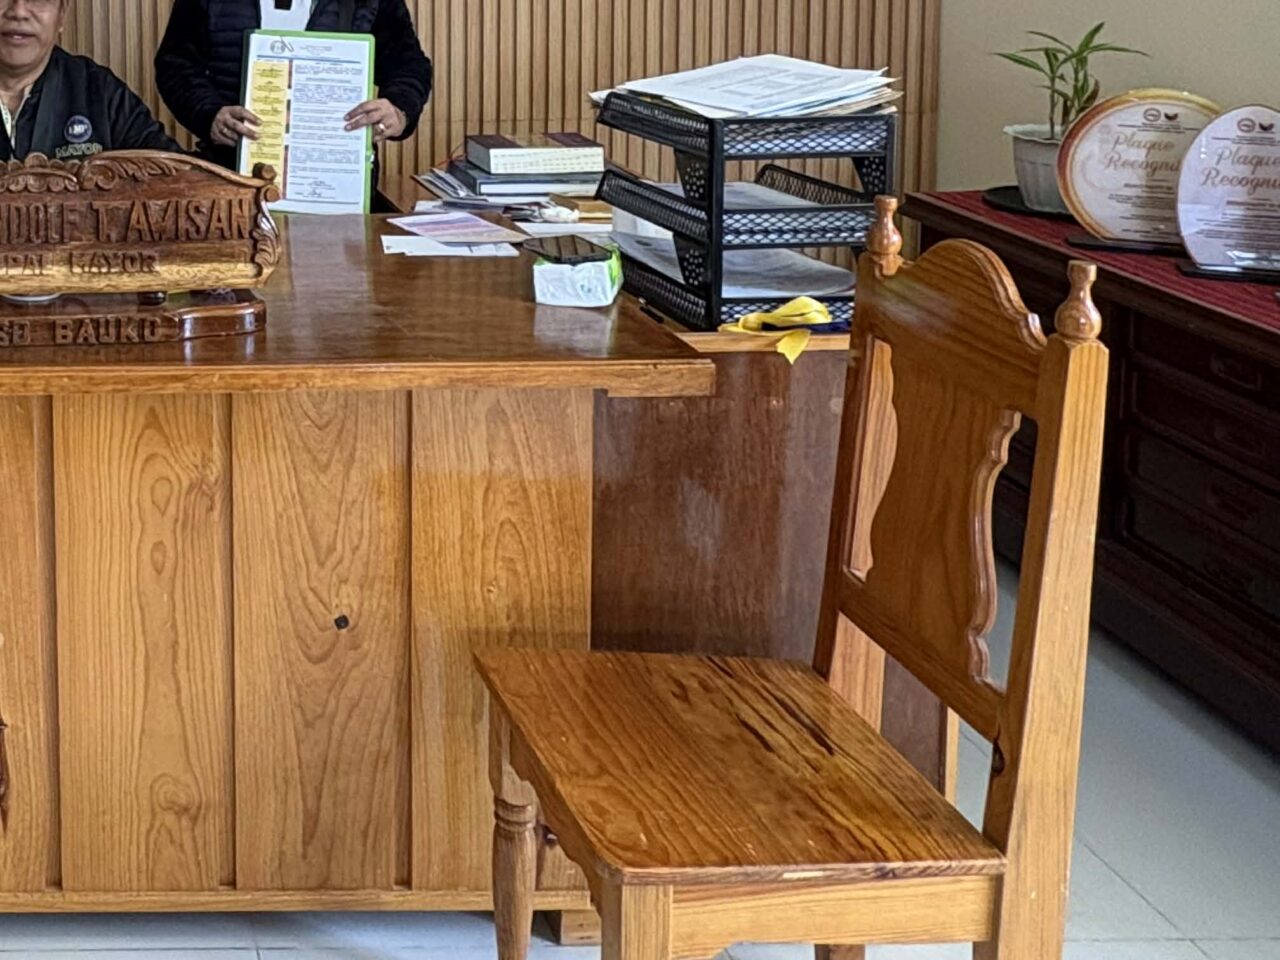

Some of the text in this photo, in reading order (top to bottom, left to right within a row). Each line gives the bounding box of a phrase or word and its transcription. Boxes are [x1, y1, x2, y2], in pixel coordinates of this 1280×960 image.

[127, 198, 252, 242] AWISAN
[69, 251, 158, 274] MAYOR
[53, 316, 162, 345] BAUKO
